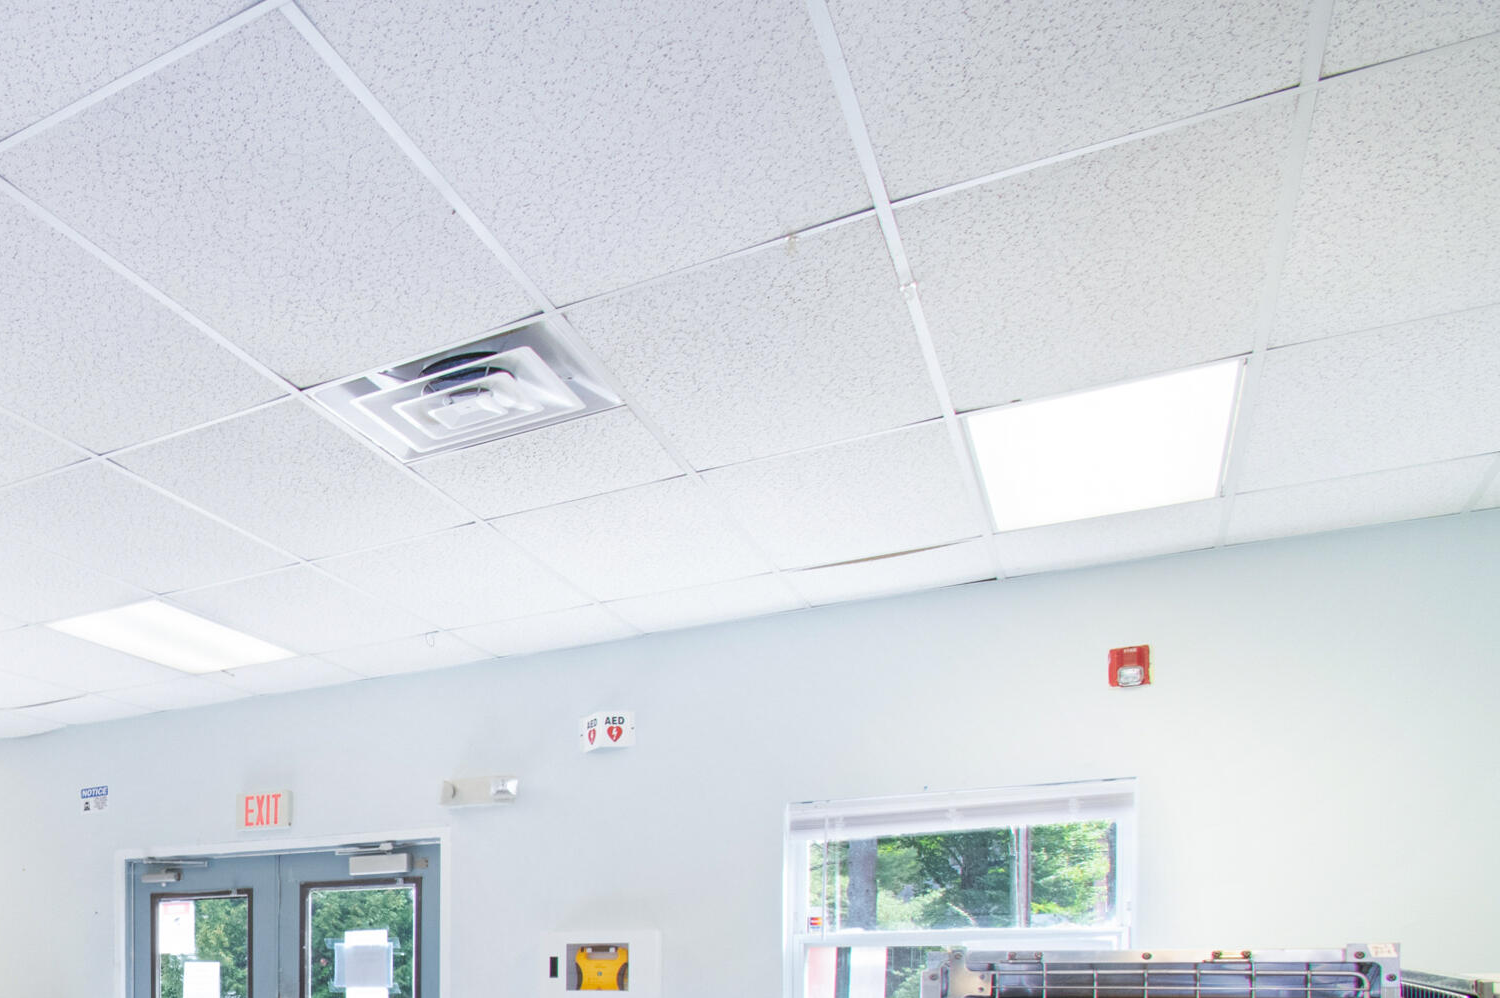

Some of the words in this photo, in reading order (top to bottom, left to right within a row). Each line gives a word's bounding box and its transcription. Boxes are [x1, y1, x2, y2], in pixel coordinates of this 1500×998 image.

[604, 716, 626, 725] AED
[82, 786, 108, 798] NOTICE
[244, 793, 282, 827] EXIT
